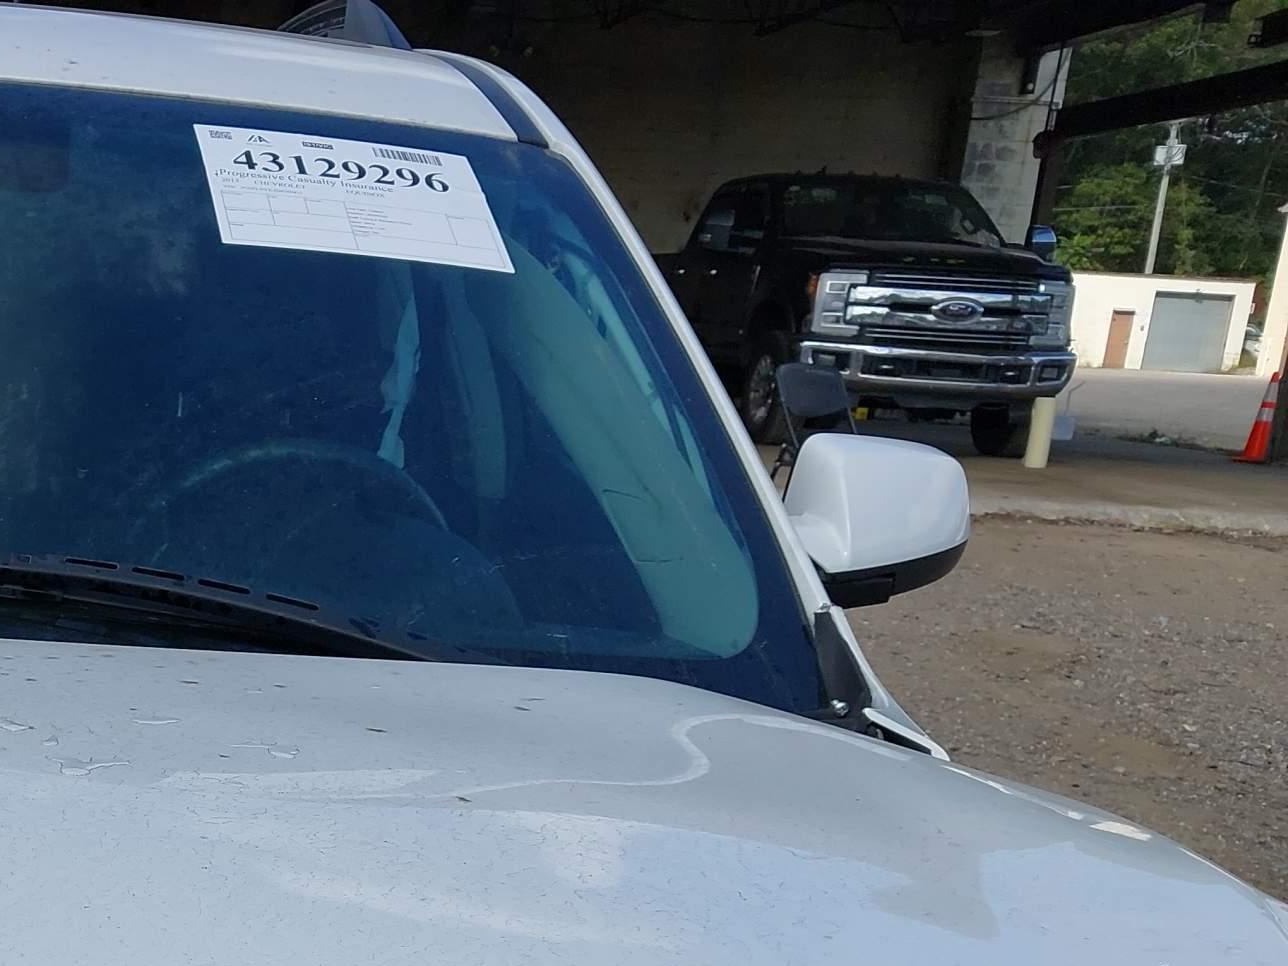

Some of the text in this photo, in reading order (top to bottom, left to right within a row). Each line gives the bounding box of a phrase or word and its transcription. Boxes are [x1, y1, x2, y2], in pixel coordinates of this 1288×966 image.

[219, 168, 394, 193] Progressive Casualty Insurance
[233, 149, 451, 194] 43129296
